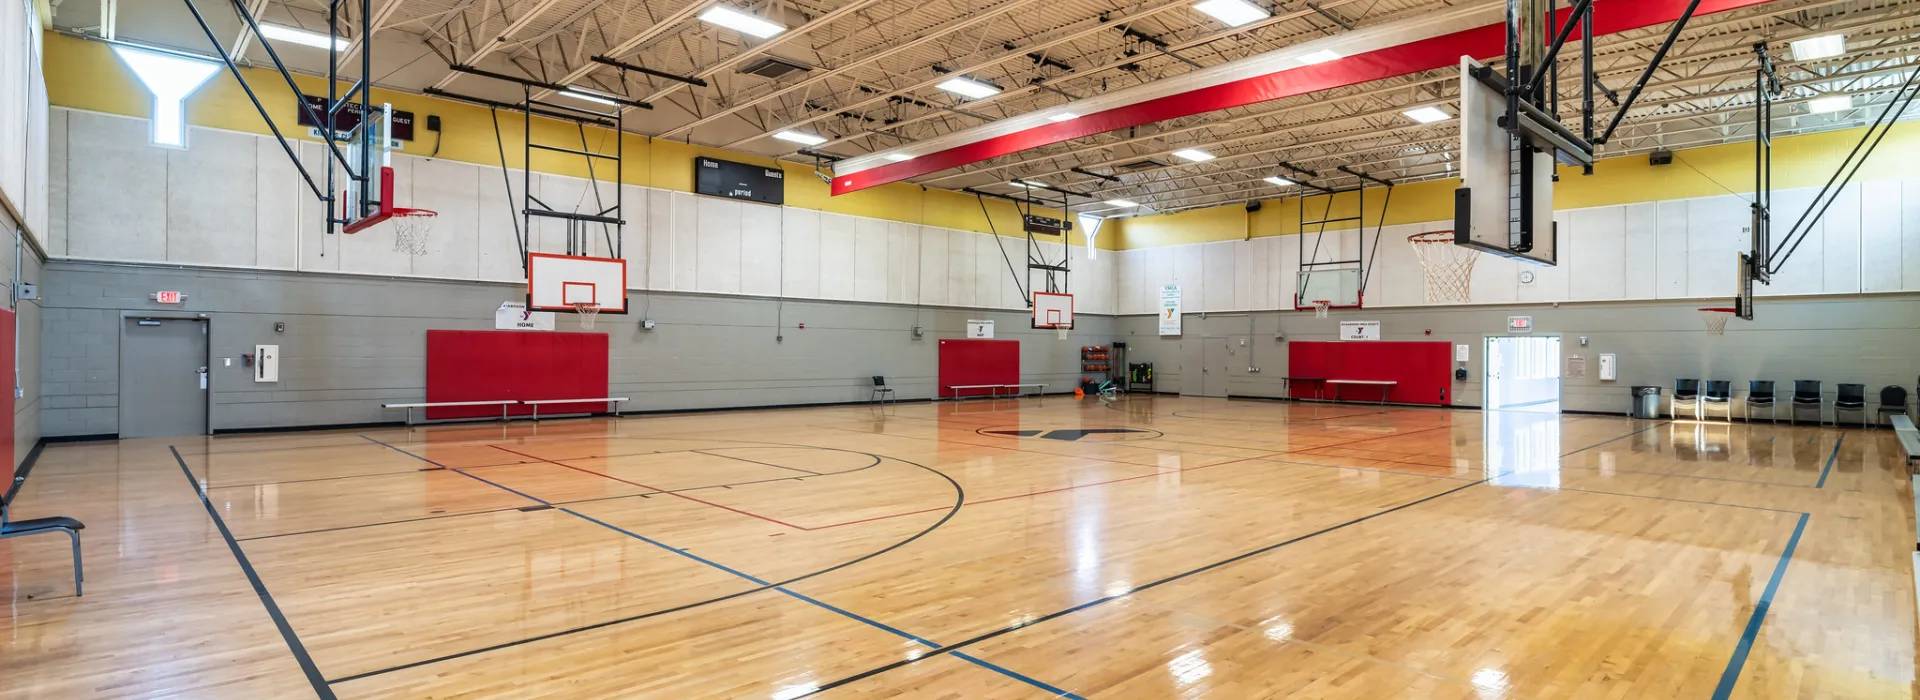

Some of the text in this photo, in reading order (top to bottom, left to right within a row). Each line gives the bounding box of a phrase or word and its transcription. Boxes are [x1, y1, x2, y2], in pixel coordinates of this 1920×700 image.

[392, 116, 411, 125] GUEST
[703, 159, 719, 169] Home
[160, 291, 177, 303] EXIT
